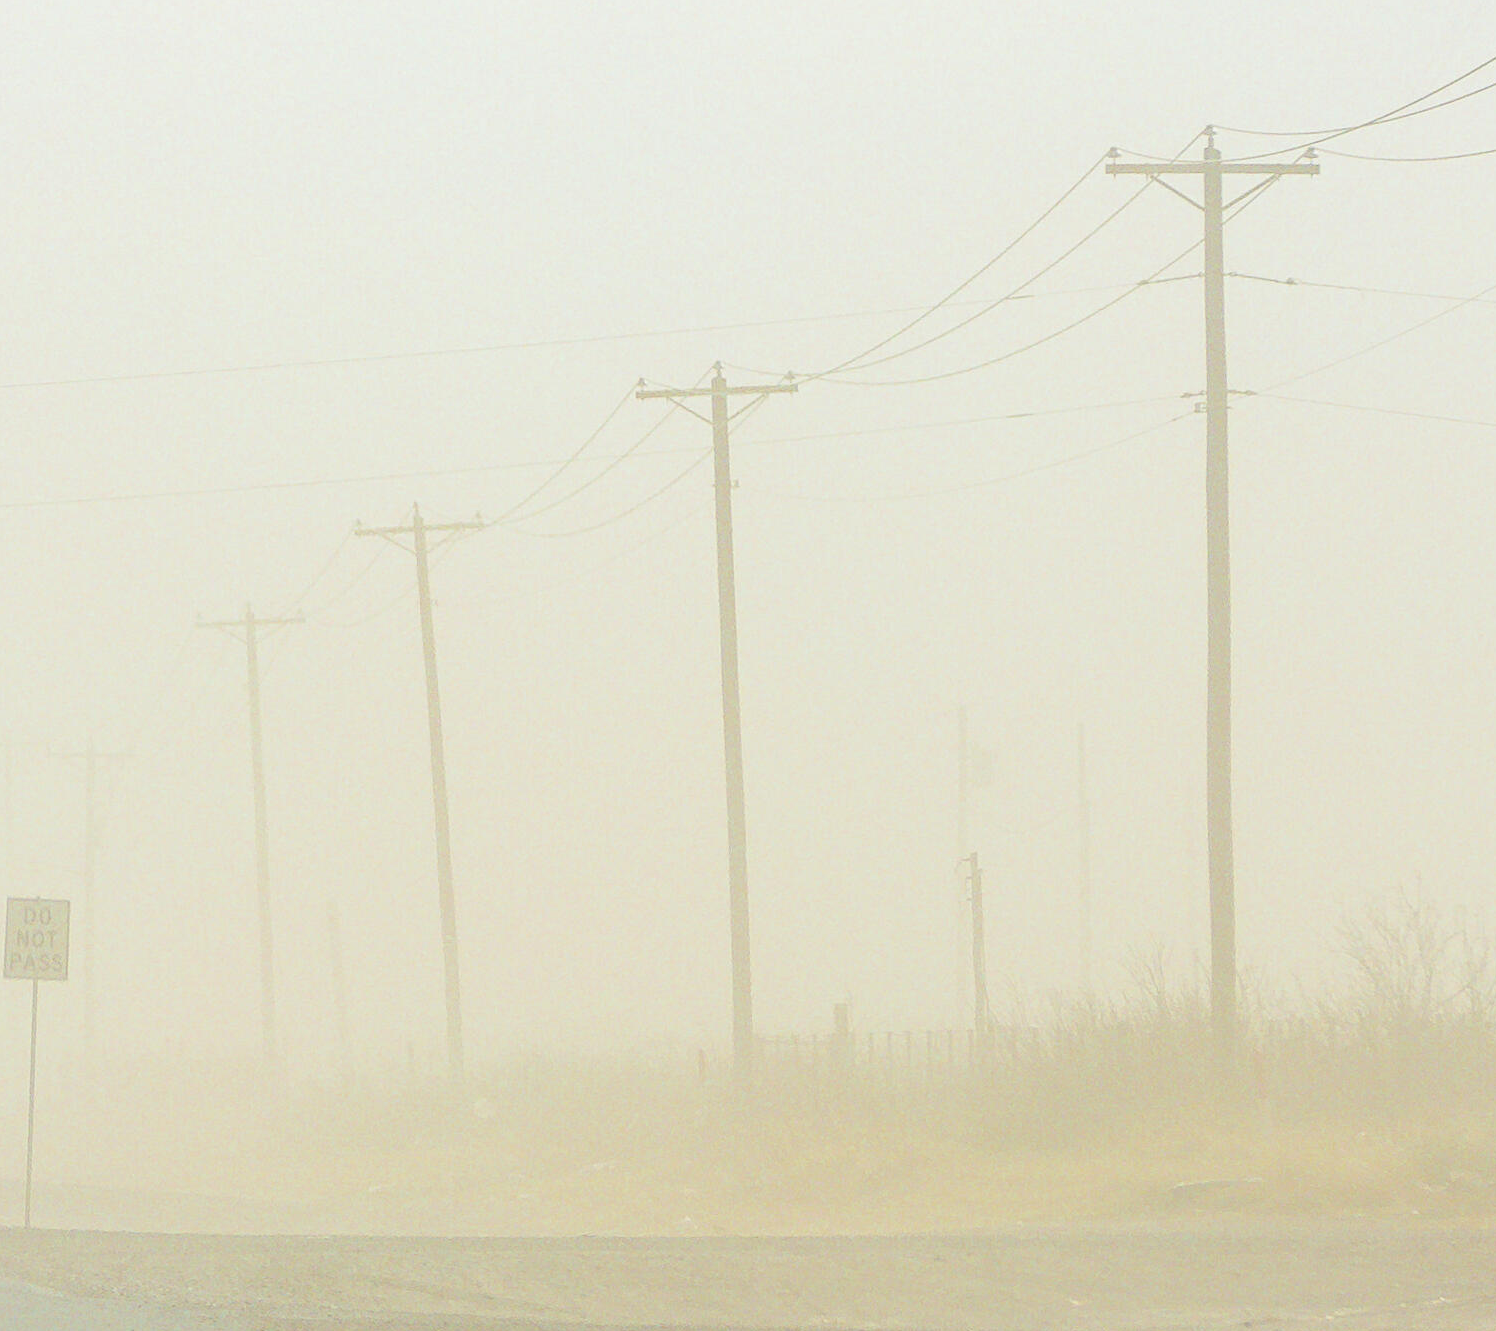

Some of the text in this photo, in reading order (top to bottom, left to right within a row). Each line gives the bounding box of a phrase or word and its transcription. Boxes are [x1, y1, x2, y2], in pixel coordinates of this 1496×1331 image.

[24, 907, 52, 925] DO
[17, 929, 57, 948] NOT
[10, 954, 63, 973] PASS
